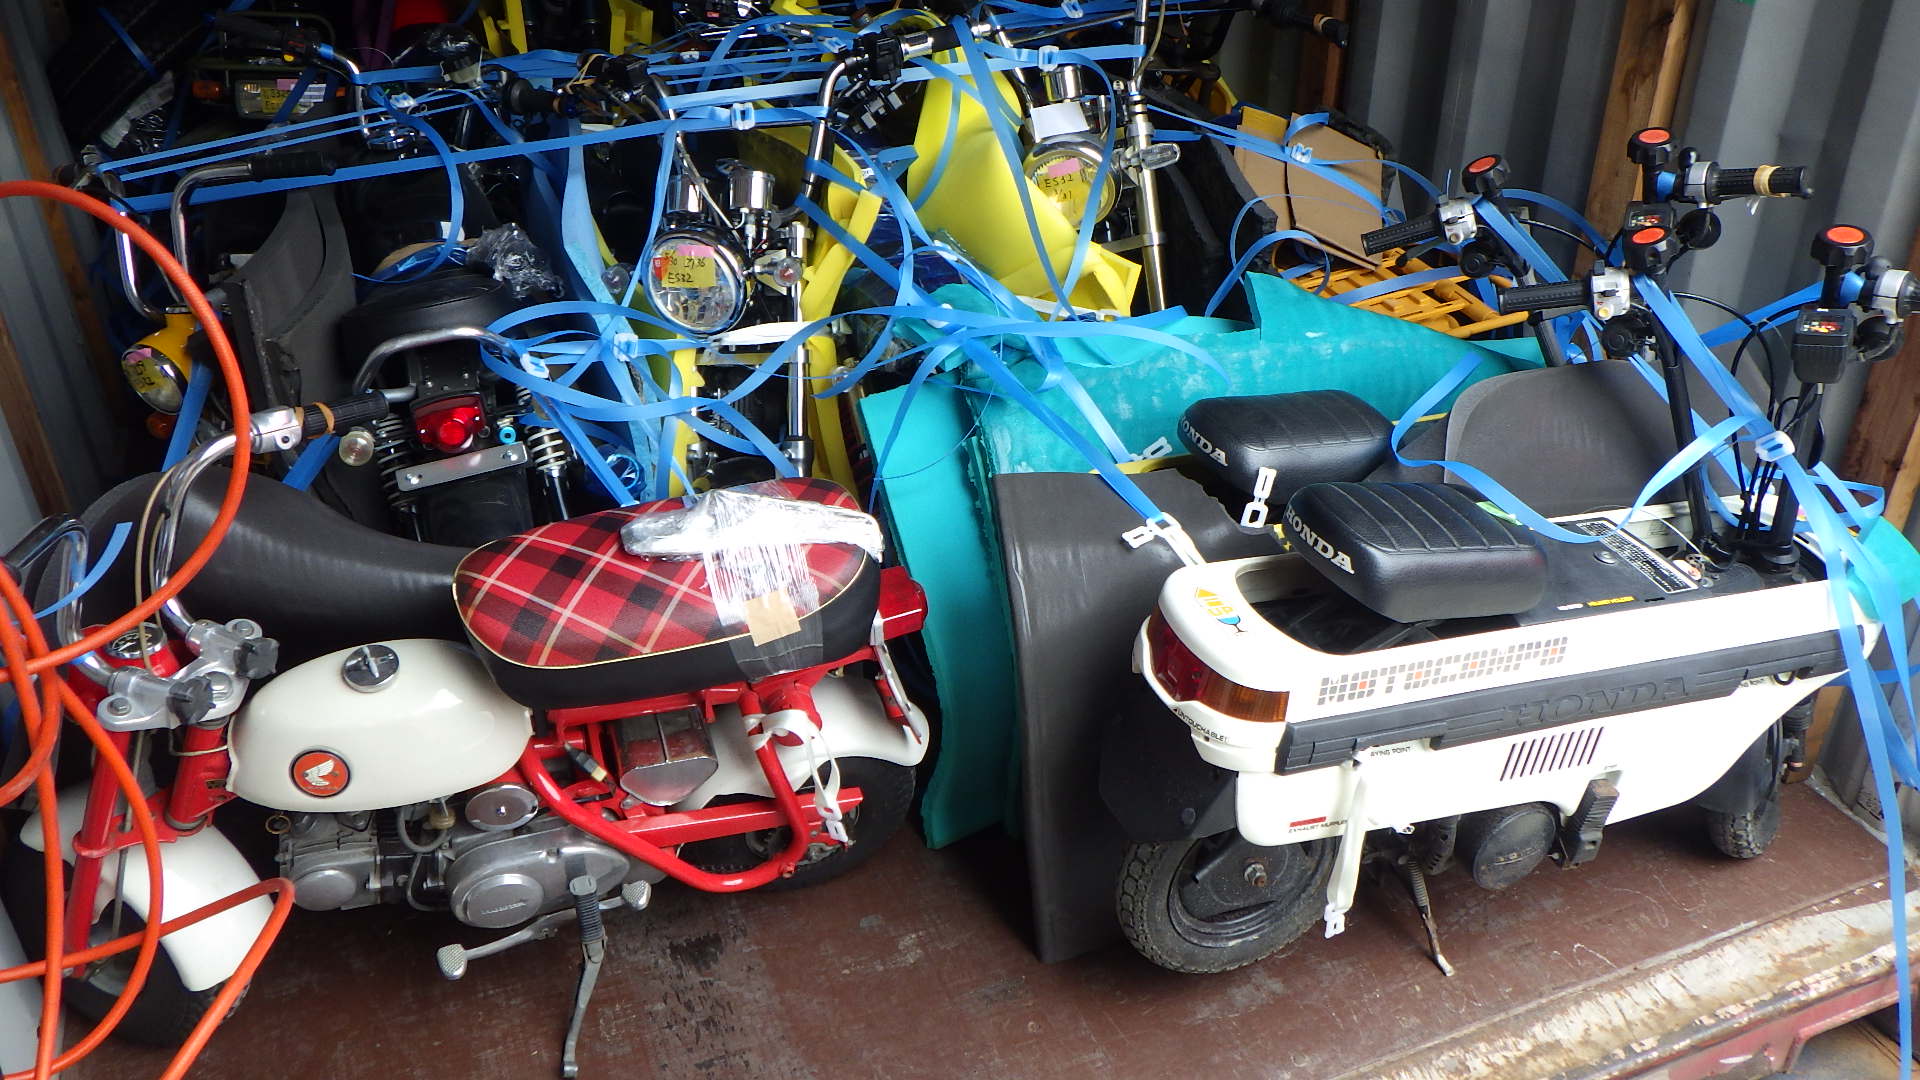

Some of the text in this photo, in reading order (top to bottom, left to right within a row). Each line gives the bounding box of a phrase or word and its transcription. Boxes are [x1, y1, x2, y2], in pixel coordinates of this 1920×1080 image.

[667, 272, 694, 284] ES32
[1285, 503, 1355, 575] HONDA
[1316, 636, 1569, 706] MOTOCOMPO
[1499, 676, 1690, 728] HONDA
